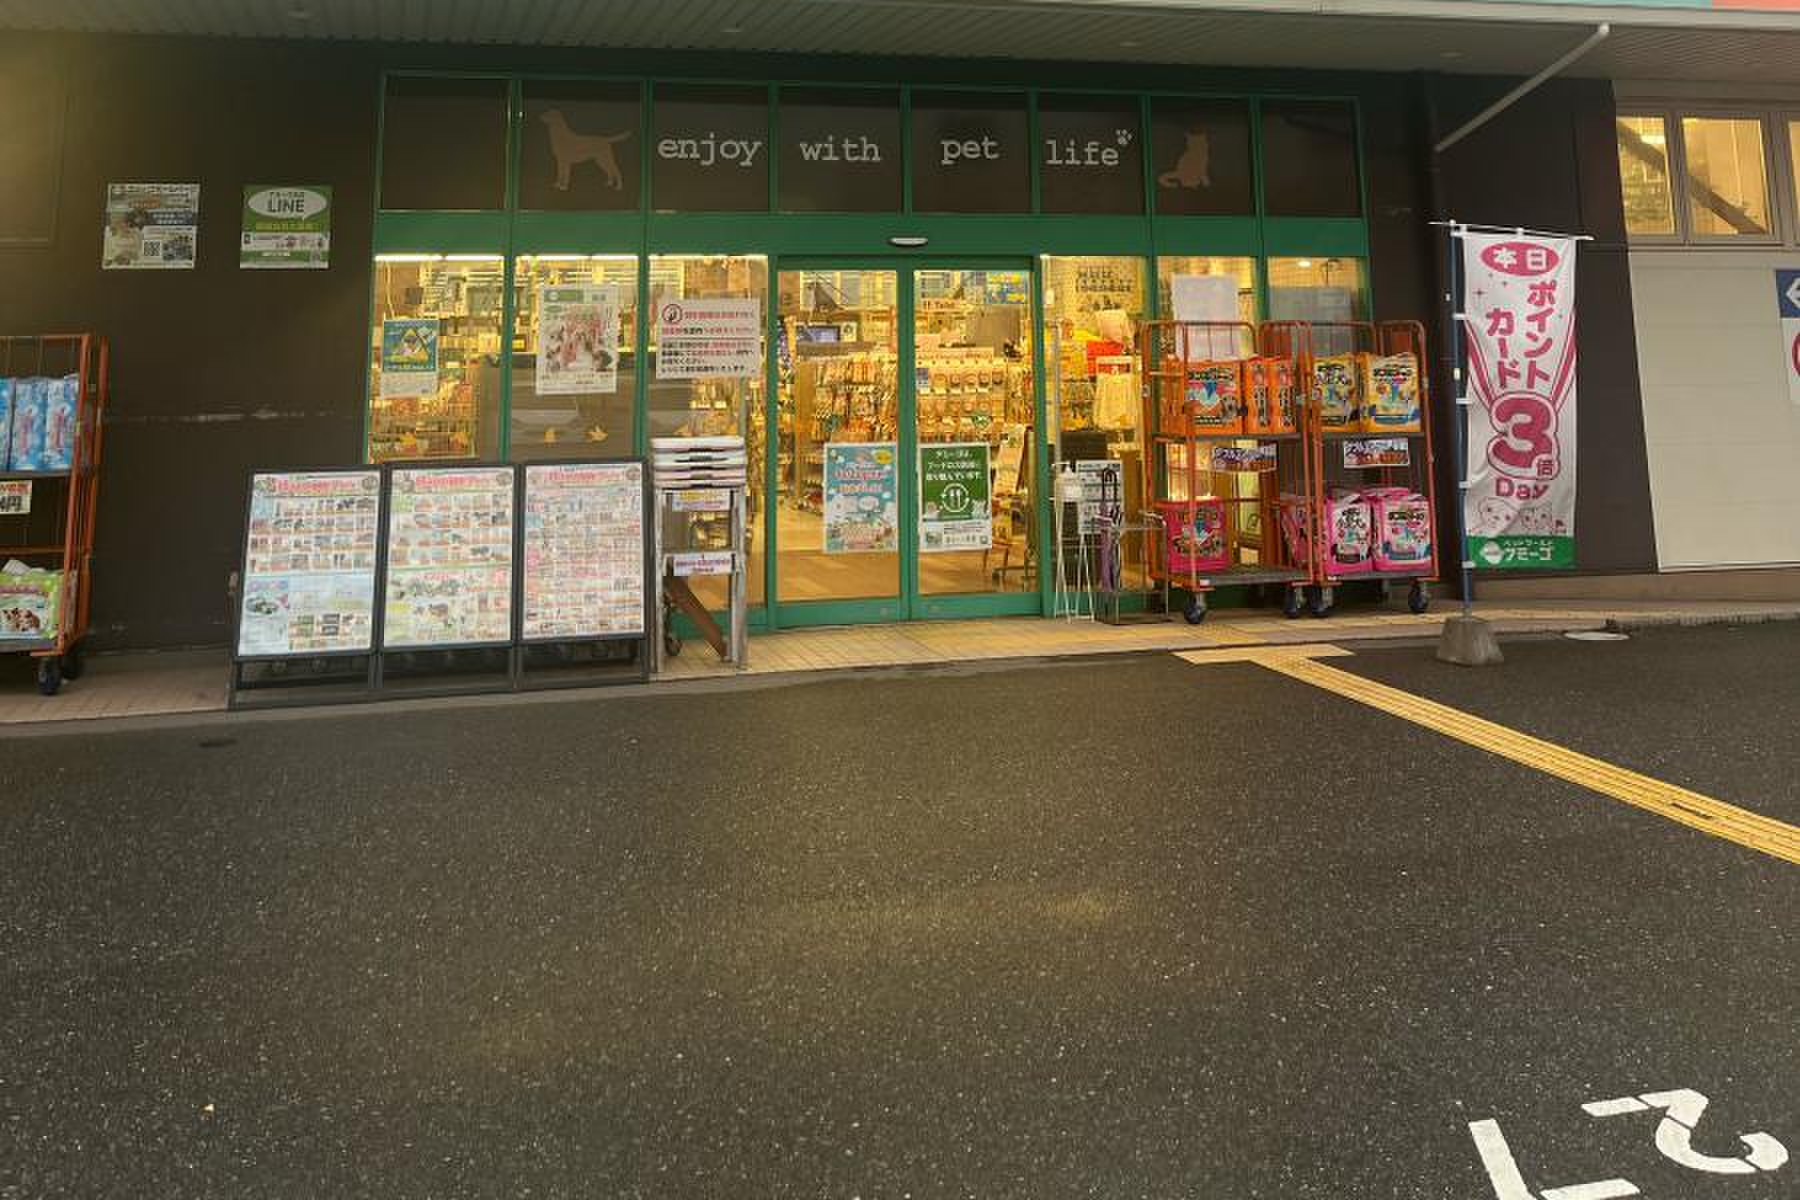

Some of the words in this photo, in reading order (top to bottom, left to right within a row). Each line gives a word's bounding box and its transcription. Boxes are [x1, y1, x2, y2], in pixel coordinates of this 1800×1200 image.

[657, 131, 763, 167] enjoy
[799, 134, 881, 161] with
[940, 135, 1000, 165] pet
[1046, 138, 1119, 166] life
[267, 199, 305, 213] LINE
[1493, 247, 1549, 272] 本日
[1485, 307, 1521, 389] カード
[1523, 278, 1558, 390] ポイント
[1495, 477, 1550, 500] Day
